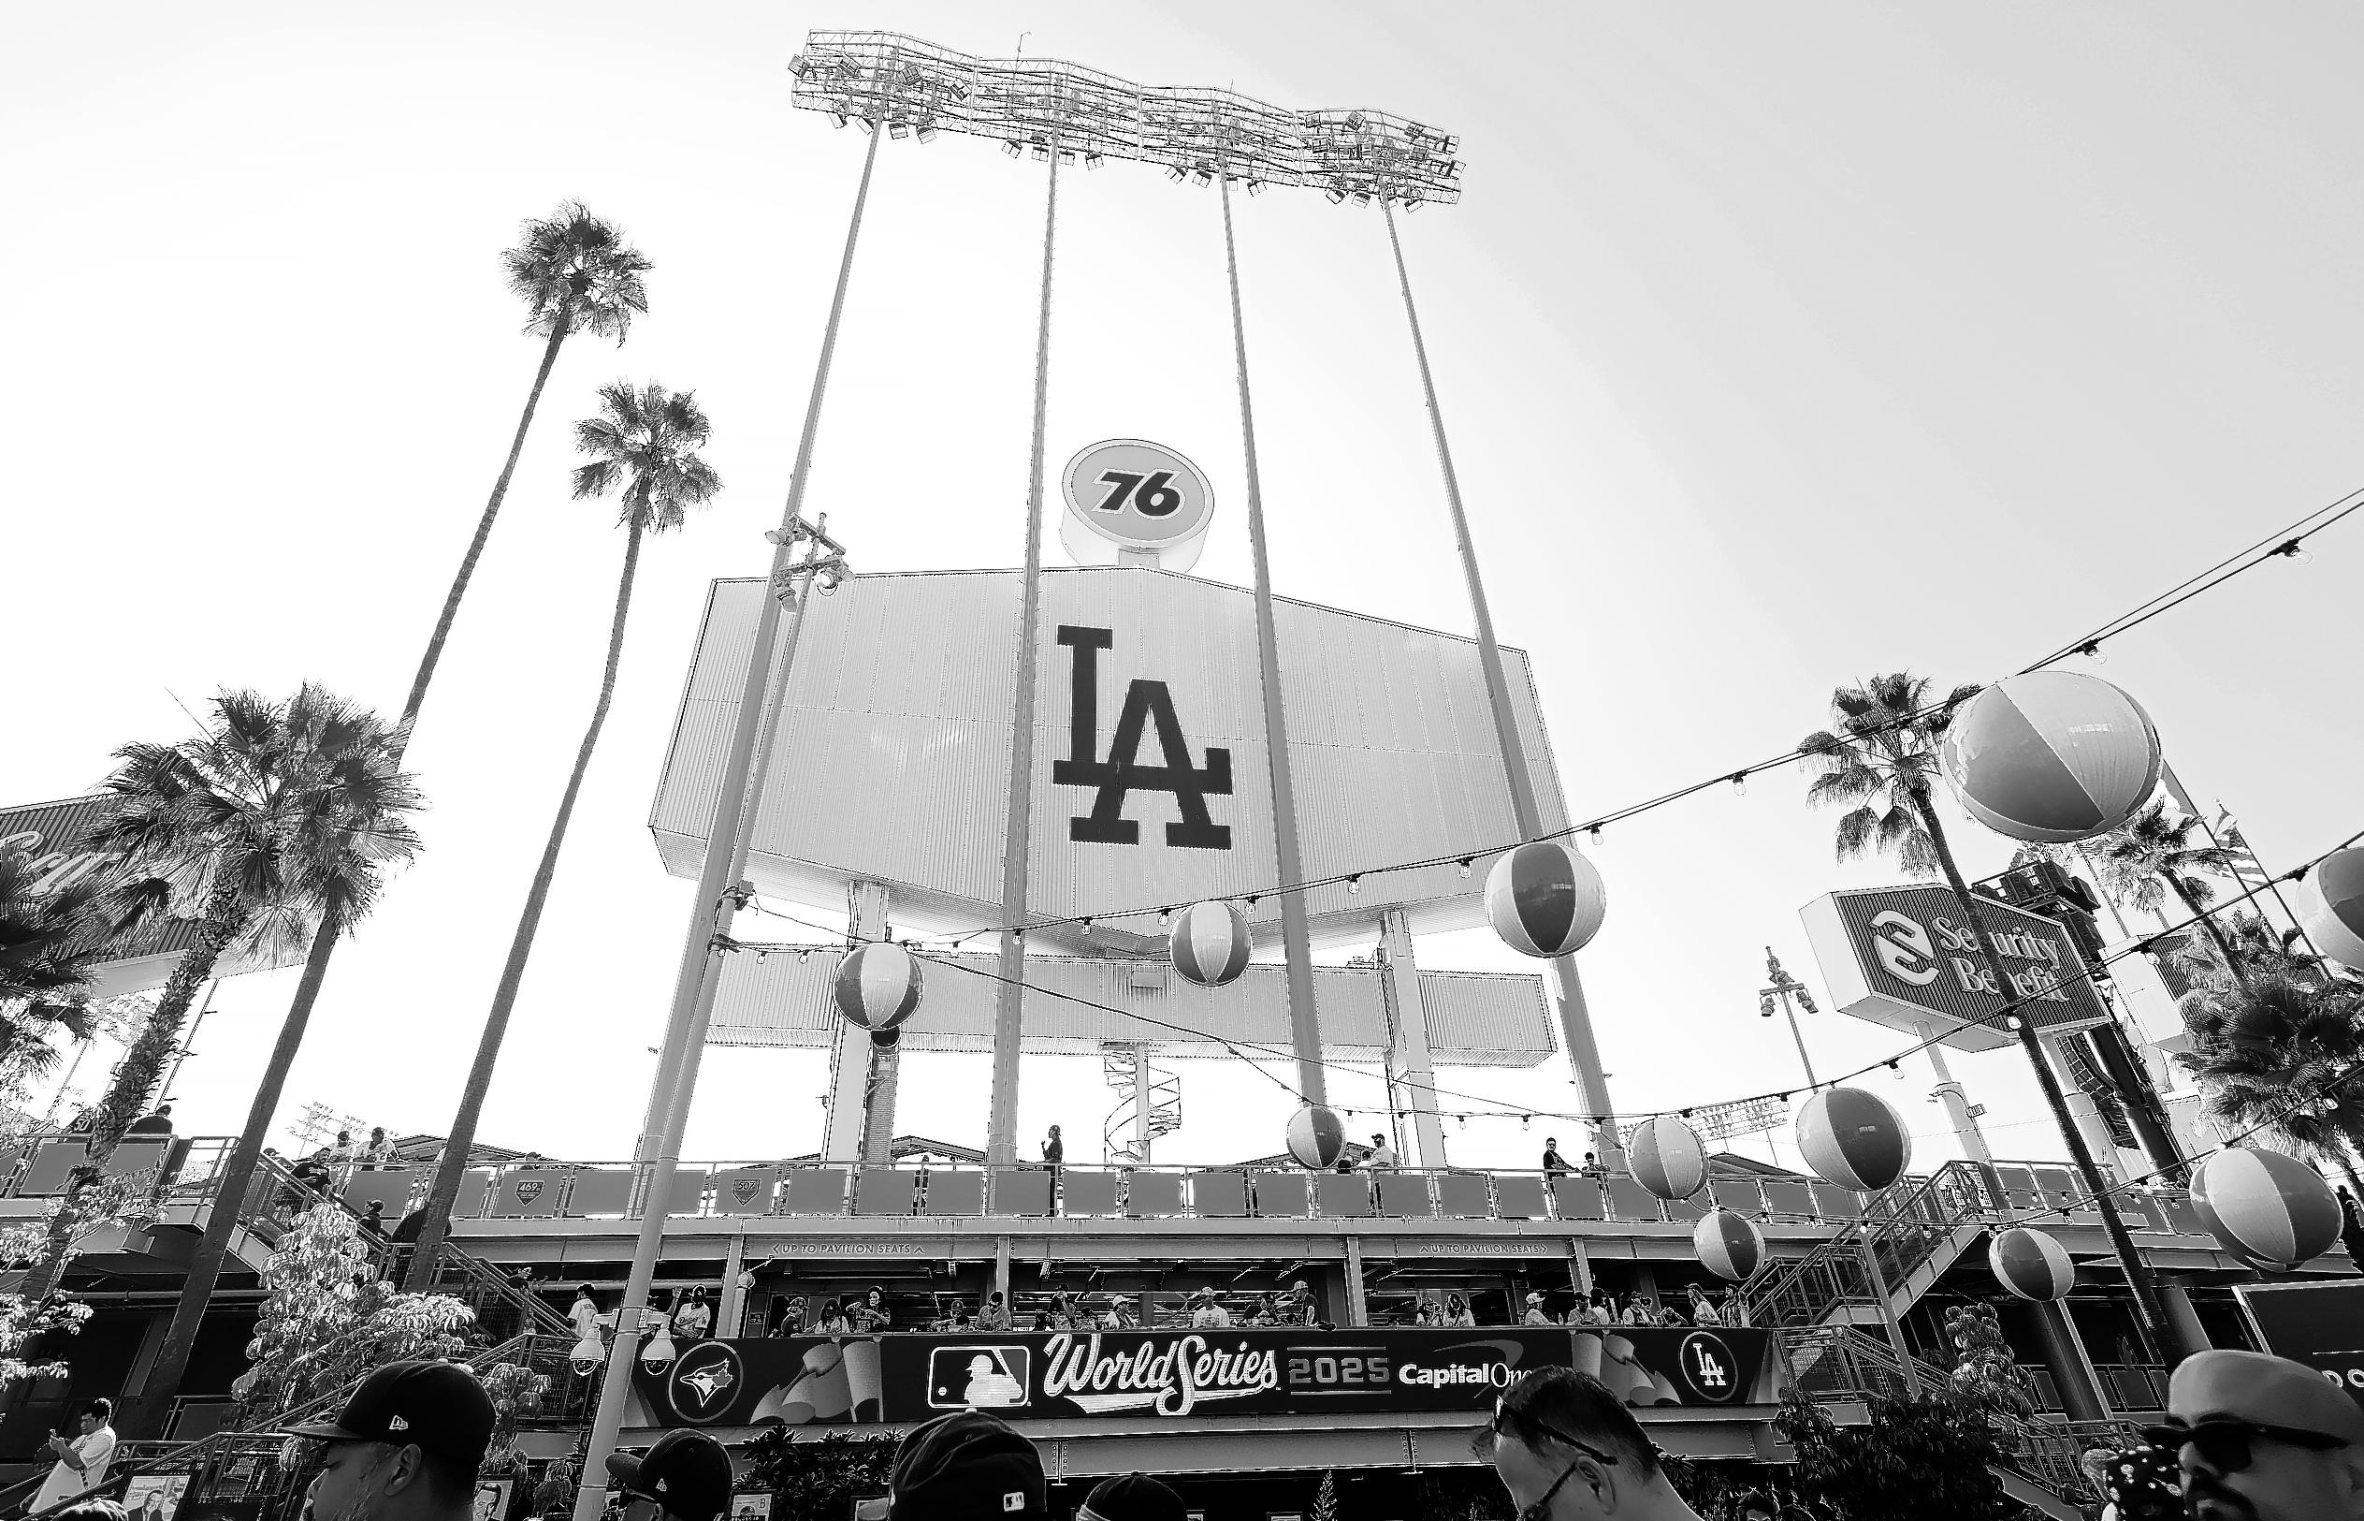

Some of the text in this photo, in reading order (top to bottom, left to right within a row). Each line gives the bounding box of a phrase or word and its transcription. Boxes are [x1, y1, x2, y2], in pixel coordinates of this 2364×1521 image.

[1097, 469, 1184, 518] 76
[1052, 624, 1233, 850] LA
[1932, 916, 2060, 971] Seurity
[519, 1182, 538, 1192] 469
[781, 1244, 910, 1254] UP TO PAVILION SEATS
[1430, 1244, 1539, 1253] UP TO PAVILION SEATS
[1043, 1333, 1278, 1416] World Series
[1289, 1357, 1390, 1384] 2025
[1692, 1342, 1726, 1386] LA
